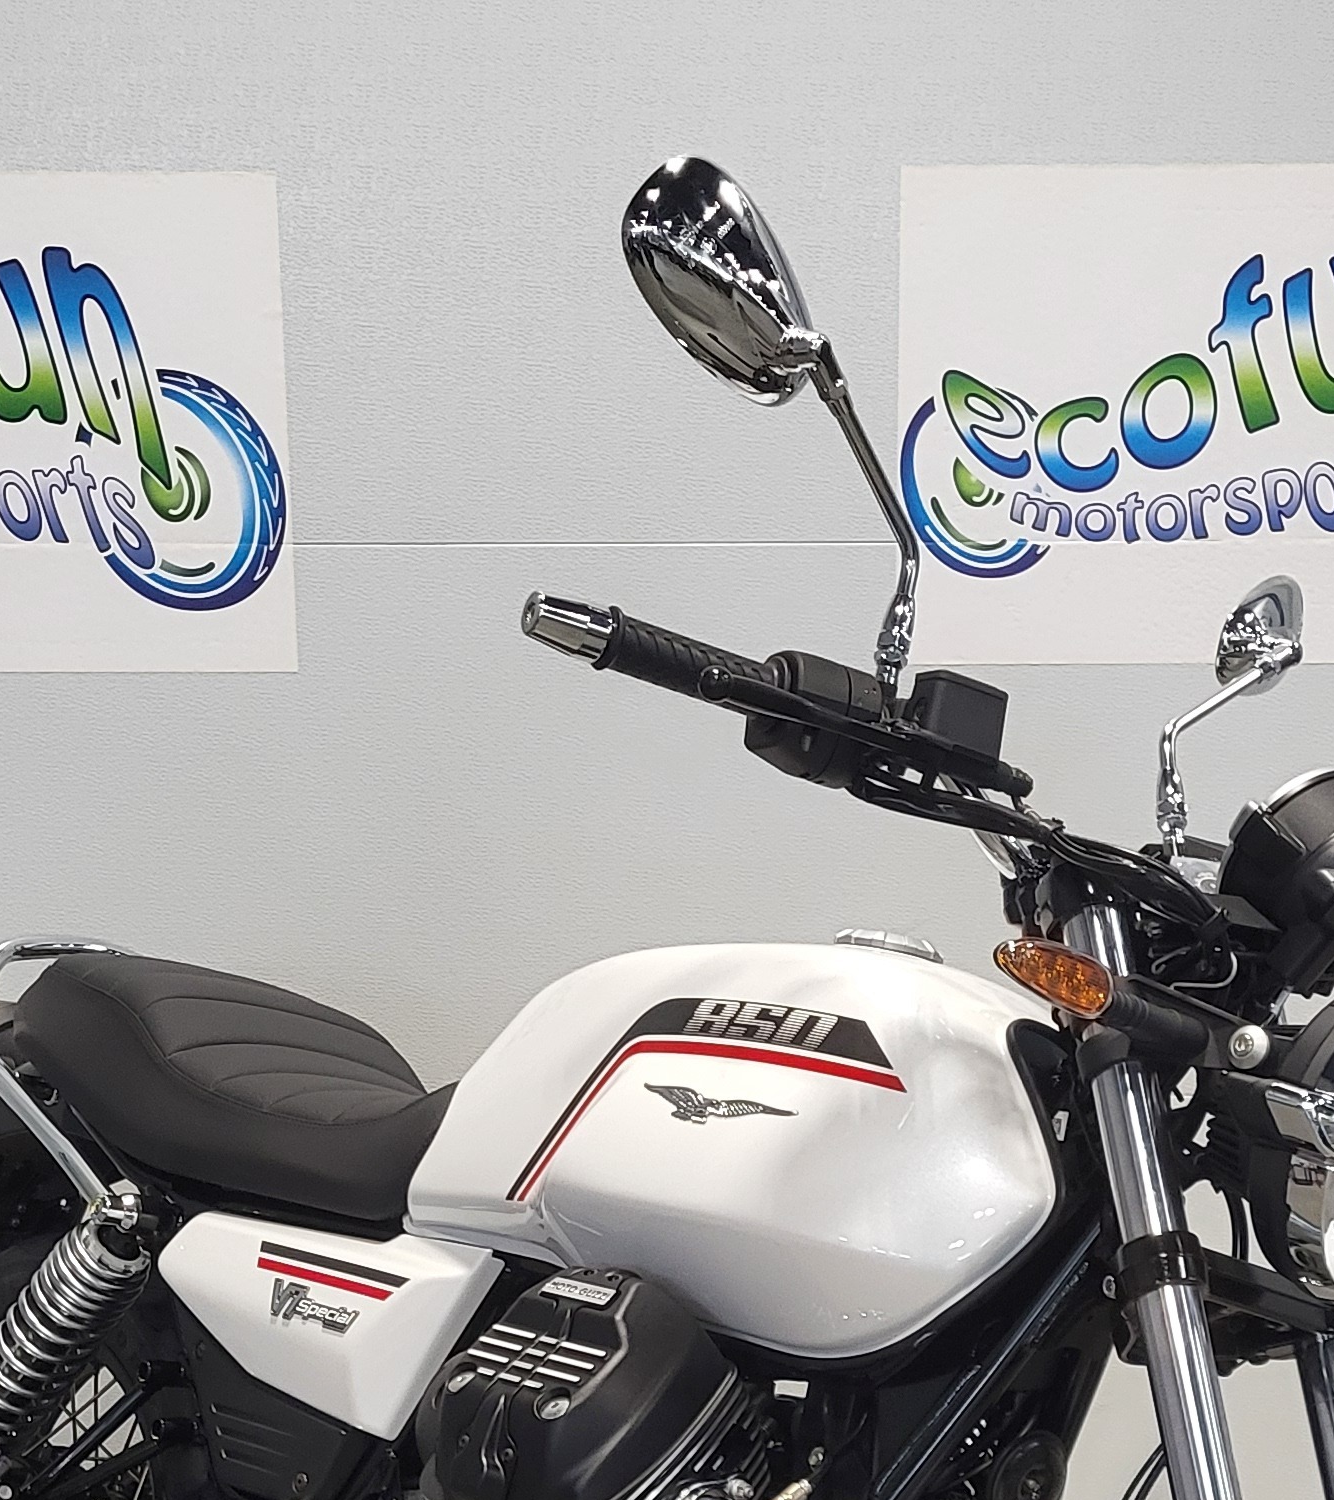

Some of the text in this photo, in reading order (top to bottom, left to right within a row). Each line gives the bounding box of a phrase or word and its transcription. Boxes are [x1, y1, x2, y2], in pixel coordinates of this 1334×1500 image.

[681, 999, 839, 1051] 850
[550, 1281, 609, 1300] MOTO GUZZI
